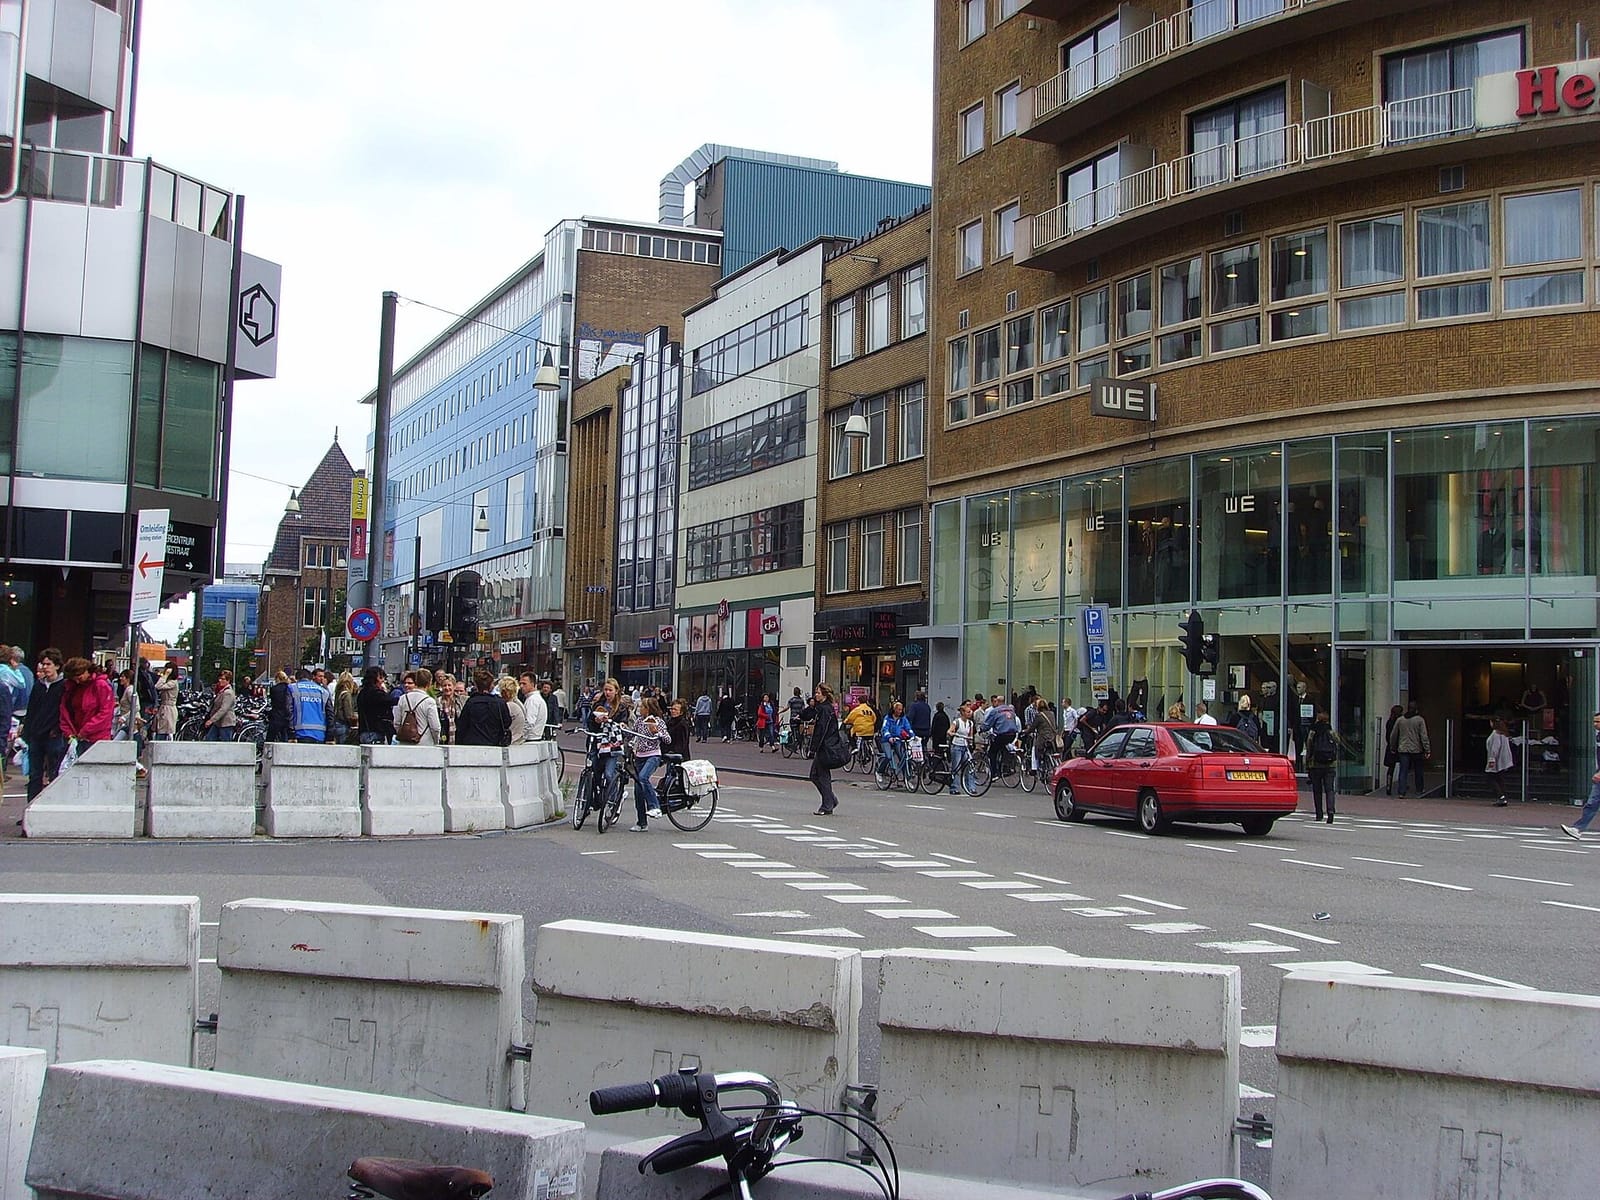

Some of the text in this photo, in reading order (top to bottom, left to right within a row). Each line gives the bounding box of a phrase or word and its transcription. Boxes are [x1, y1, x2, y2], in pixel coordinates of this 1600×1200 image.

[1515, 66, 1600, 117] He
[1101, 385, 1145, 412] WE
[1225, 495, 1255, 514] WE
[140, 523, 166, 534] Omleiding
[1085, 515, 1105, 532] WE
[981, 532, 1001, 547] WE
[1089, 611, 1099, 626] P
[1092, 645, 1102, 660] P
